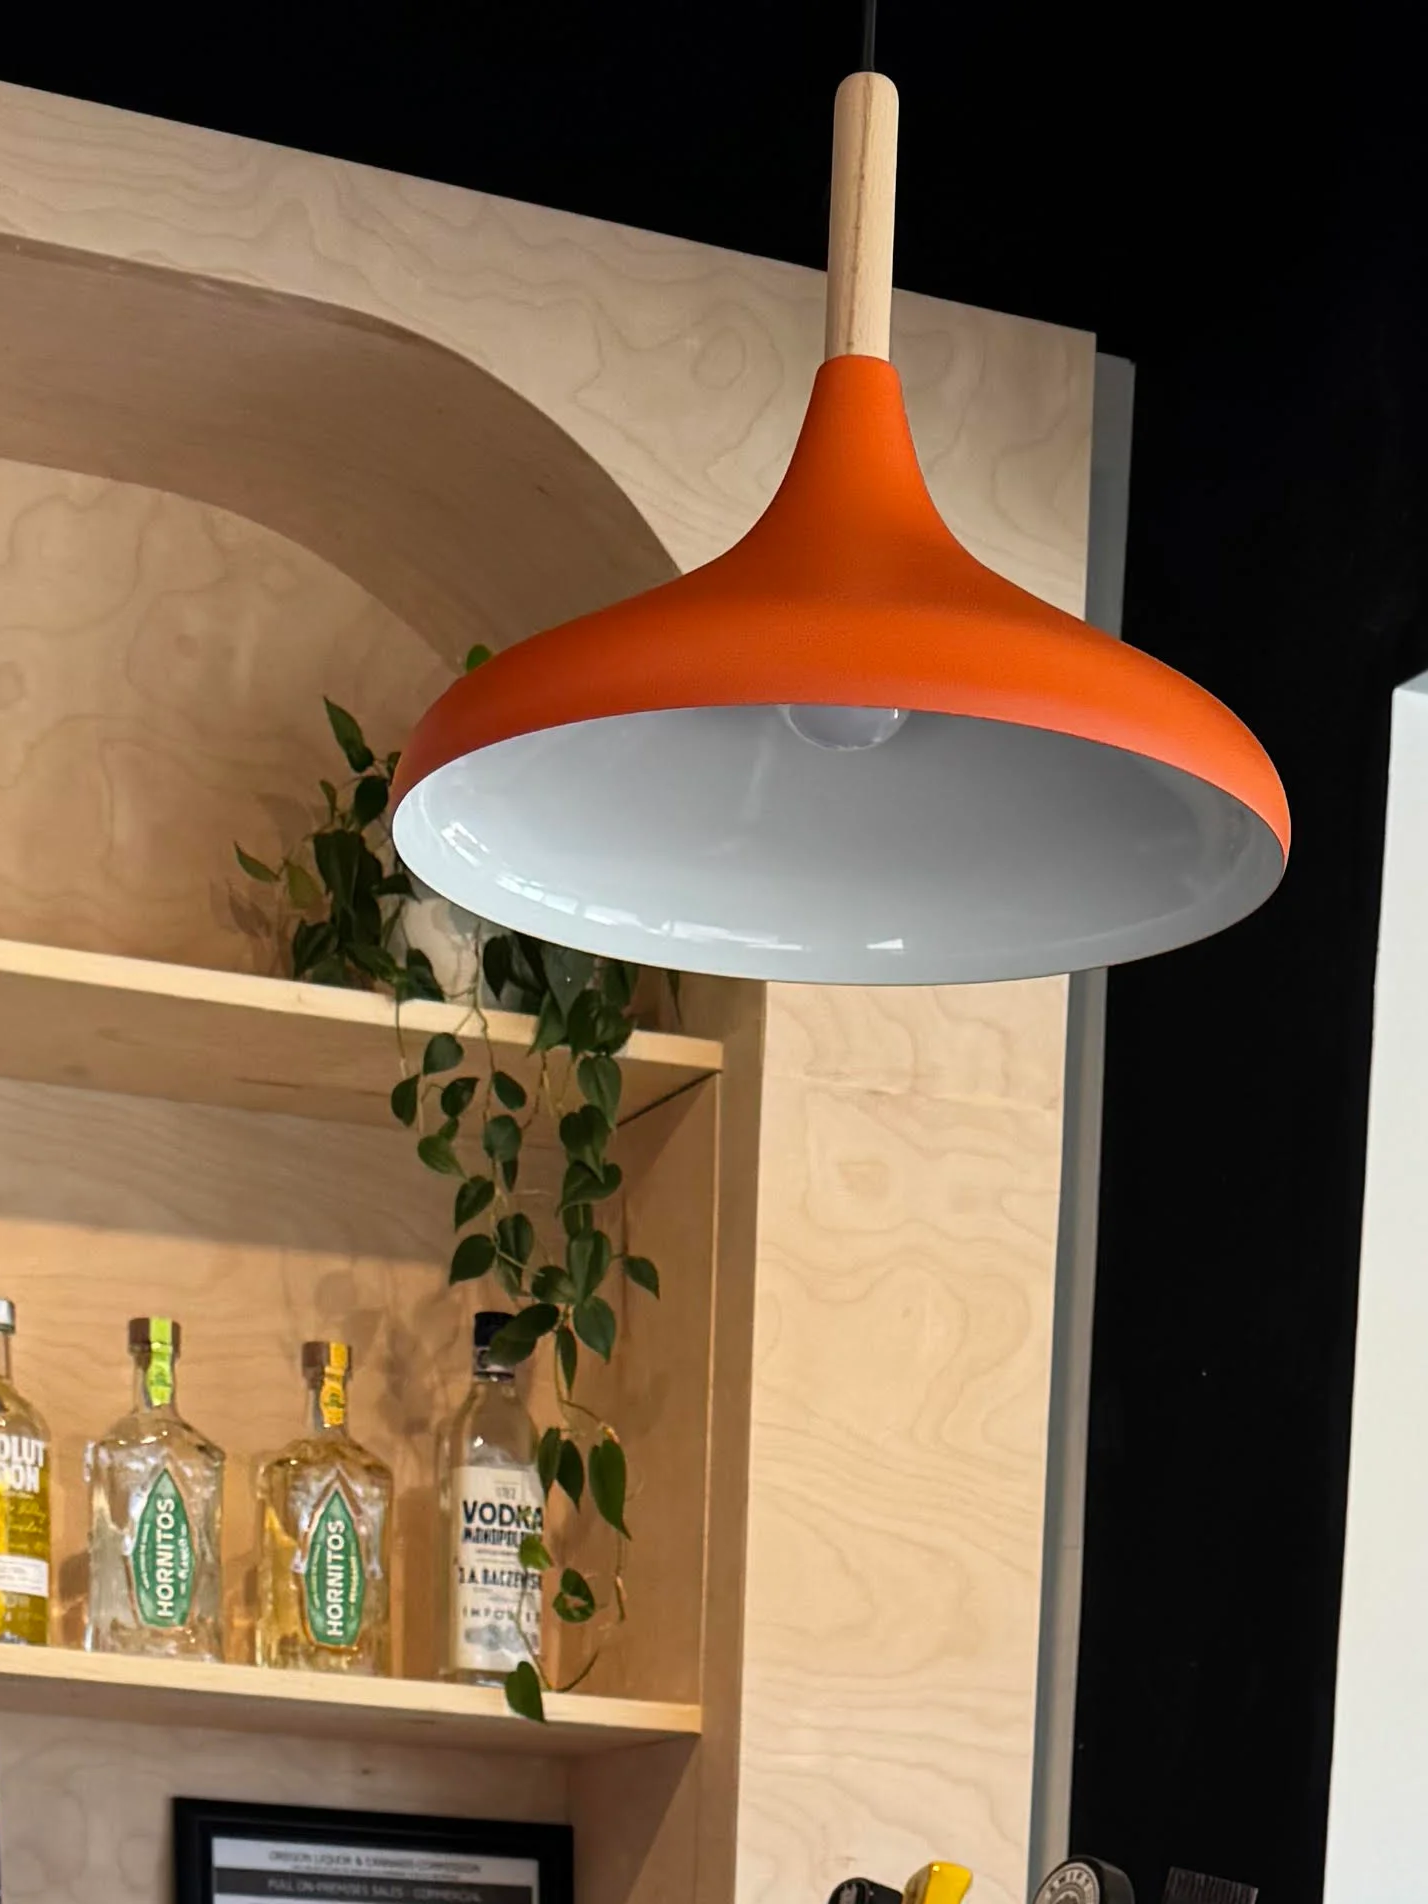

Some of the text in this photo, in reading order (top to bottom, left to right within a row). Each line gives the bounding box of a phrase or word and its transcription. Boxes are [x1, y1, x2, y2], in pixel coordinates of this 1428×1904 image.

[156, 1498, 175, 1618] HORNITOS
[326, 1520, 345, 1637] HORNITOS
[1045, 1871, 1093, 1898] SWIFT
